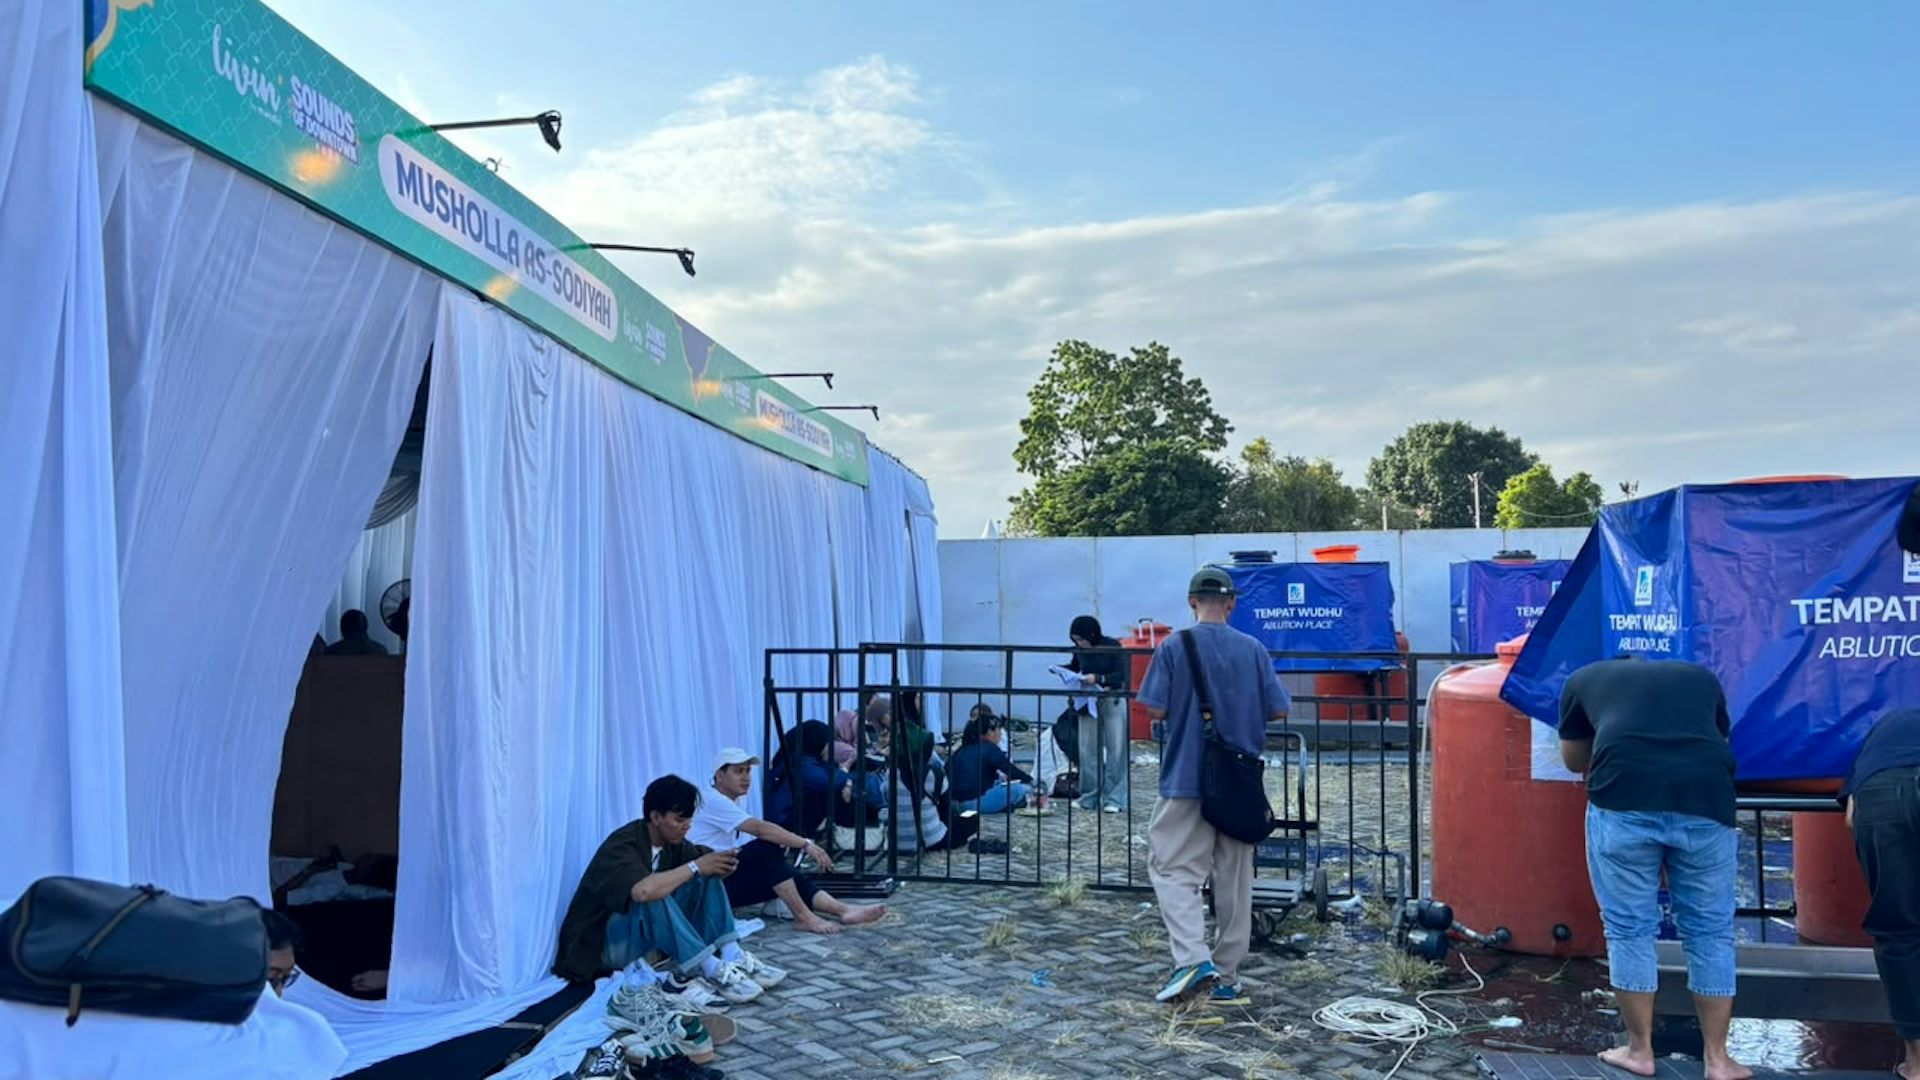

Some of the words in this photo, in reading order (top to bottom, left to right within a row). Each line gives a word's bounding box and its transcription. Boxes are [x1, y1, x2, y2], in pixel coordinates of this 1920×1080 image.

[290, 75, 356, 144] SOUNDS
[305, 116, 358, 162] DOWNTOWN
[395, 151, 520, 268] MUSHOLLA
[524, 240, 612, 330] AS-SODIYAH
[1254, 608, 1295, 619] TEMPAT
[1298, 607, 1342, 618] WUDHU
[1262, 621, 1303, 630] ABLUTION
[1304, 620, 1334, 629] PLACE
[1790, 595, 1920, 625] TEMPAT
